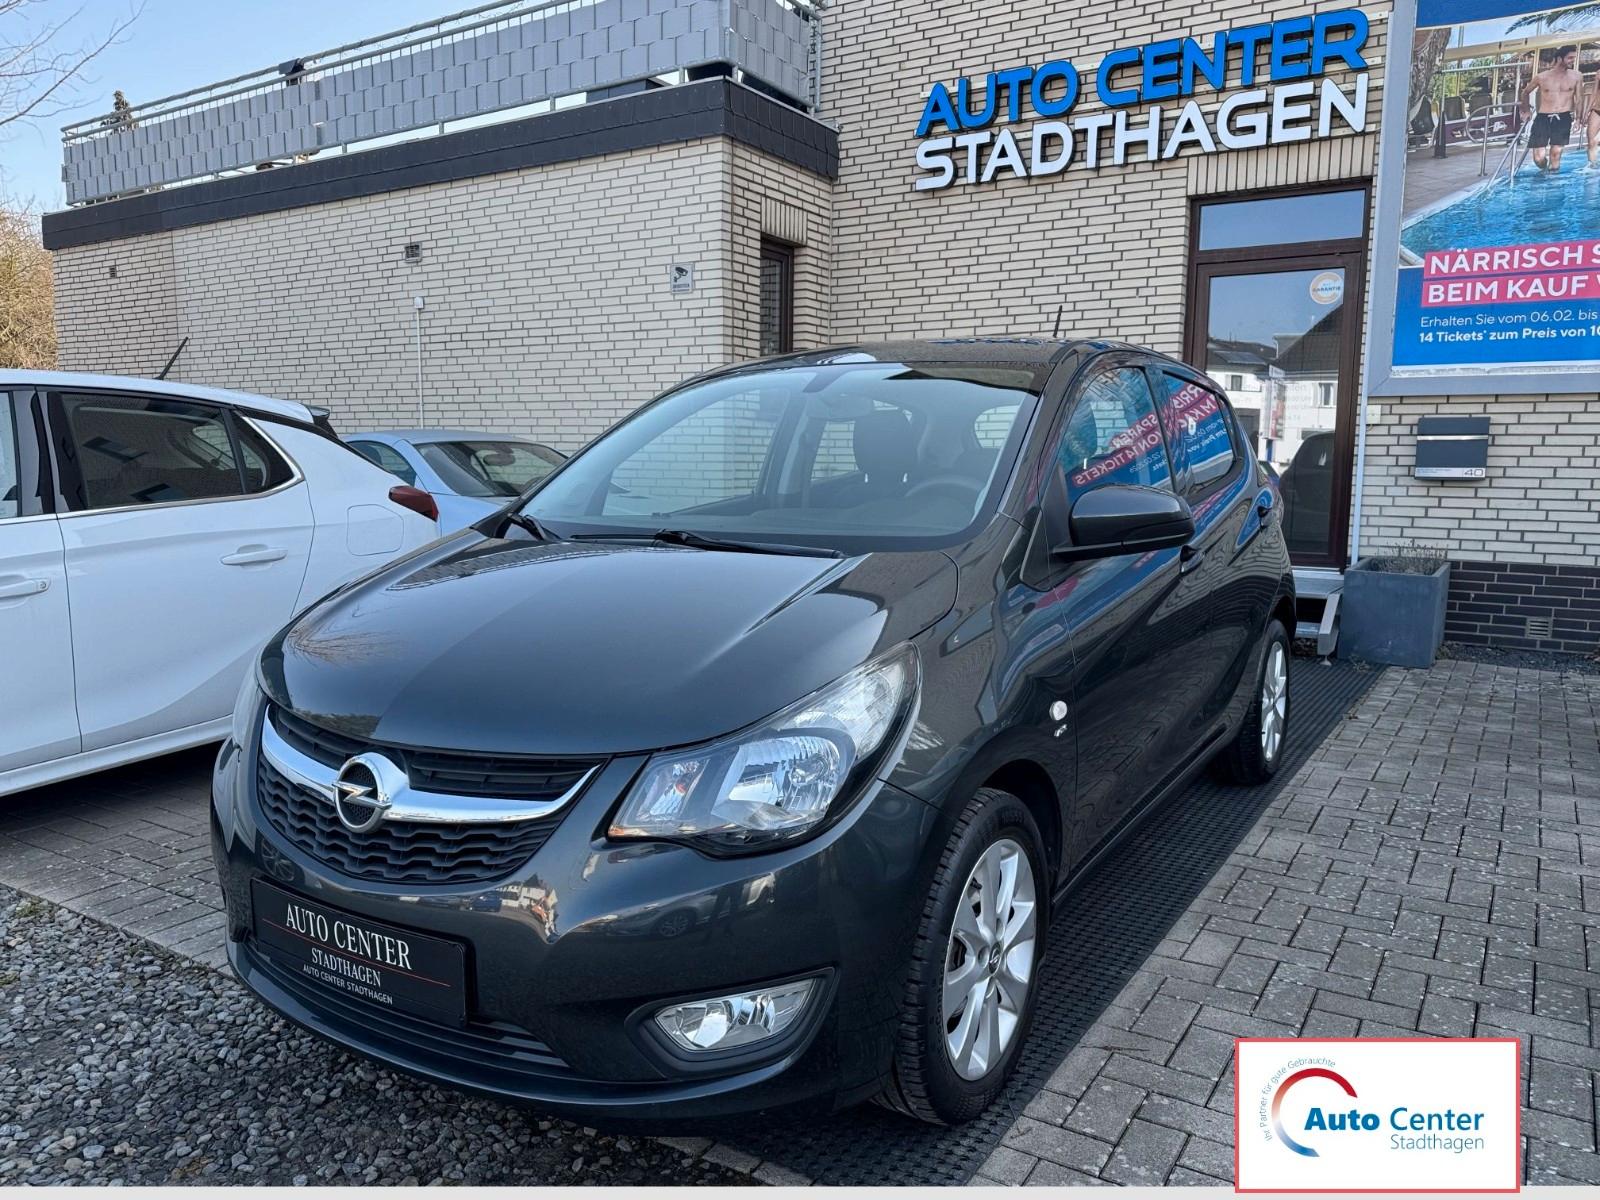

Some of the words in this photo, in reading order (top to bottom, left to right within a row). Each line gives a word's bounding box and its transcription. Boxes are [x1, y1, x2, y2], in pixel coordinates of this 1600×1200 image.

[915, 60, 1081, 137] AUTO
[1096, 8, 1370, 108] CENTER
[914, 72, 1370, 191] STADTHAGEN
[1430, 245, 1583, 275] NÄRRISCH
[1428, 280, 1498, 304] BEIM
[1506, 274, 1589, 299] KAUF
[1419, 331, 1434, 343] 14
[1488, 330, 1518, 340] zum
[1521, 326, 1557, 339] Preis
[1560, 327, 1586, 337] von
[1420, 315, 1473, 328] Erhalten
[1475, 313, 1496, 325] Sie
[1498, 314, 1527, 324] vom
[1530, 309, 1575, 323] 06.02.
[1578, 308, 1598, 321] bis
[1463, 468, 1484, 477] 40
[286, 903, 329, 942] AUTO
[333, 920, 413, 970] CENTER
[303, 964, 320, 979] AUTO
[320, 970, 346, 989] CENTER
[346, 981, 393, 1005] STADTHAGEN
[311, 947, 382, 988] STADTHAGEN
